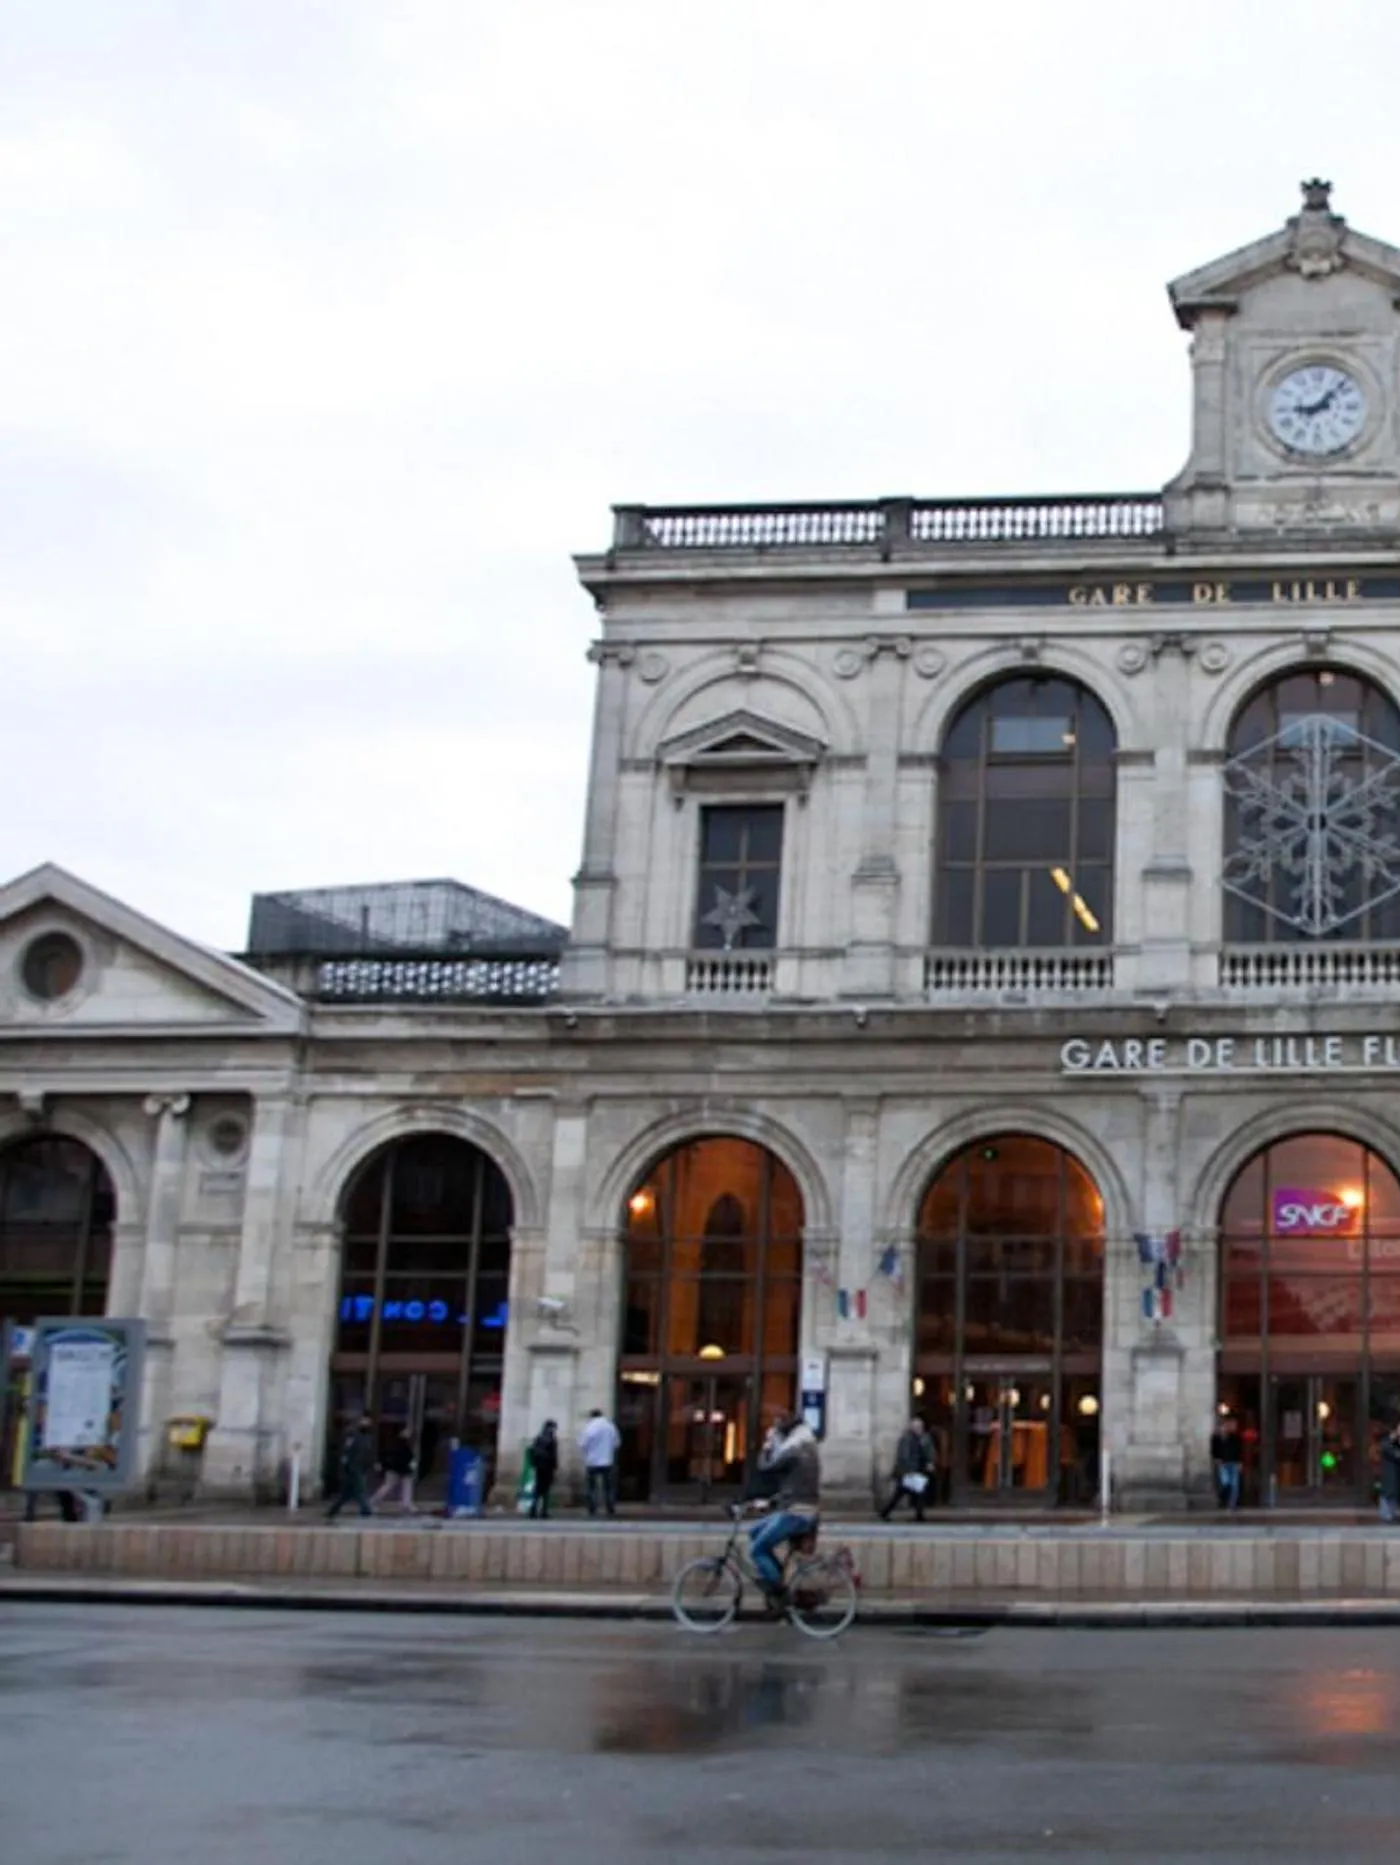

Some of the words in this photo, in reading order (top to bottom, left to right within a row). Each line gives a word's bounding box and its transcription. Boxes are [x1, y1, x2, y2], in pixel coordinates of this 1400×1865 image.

[1068, 582, 1154, 605] GARE
[1192, 580, 1231, 602] DE
[1273, 579, 1362, 602] LILLE
[1060, 1038, 1167, 1069] GARE
[1187, 1038, 1235, 1068] DE
[1254, 1037, 1342, 1067] LILLE
[1276, 1203, 1348, 1228] SNCF
